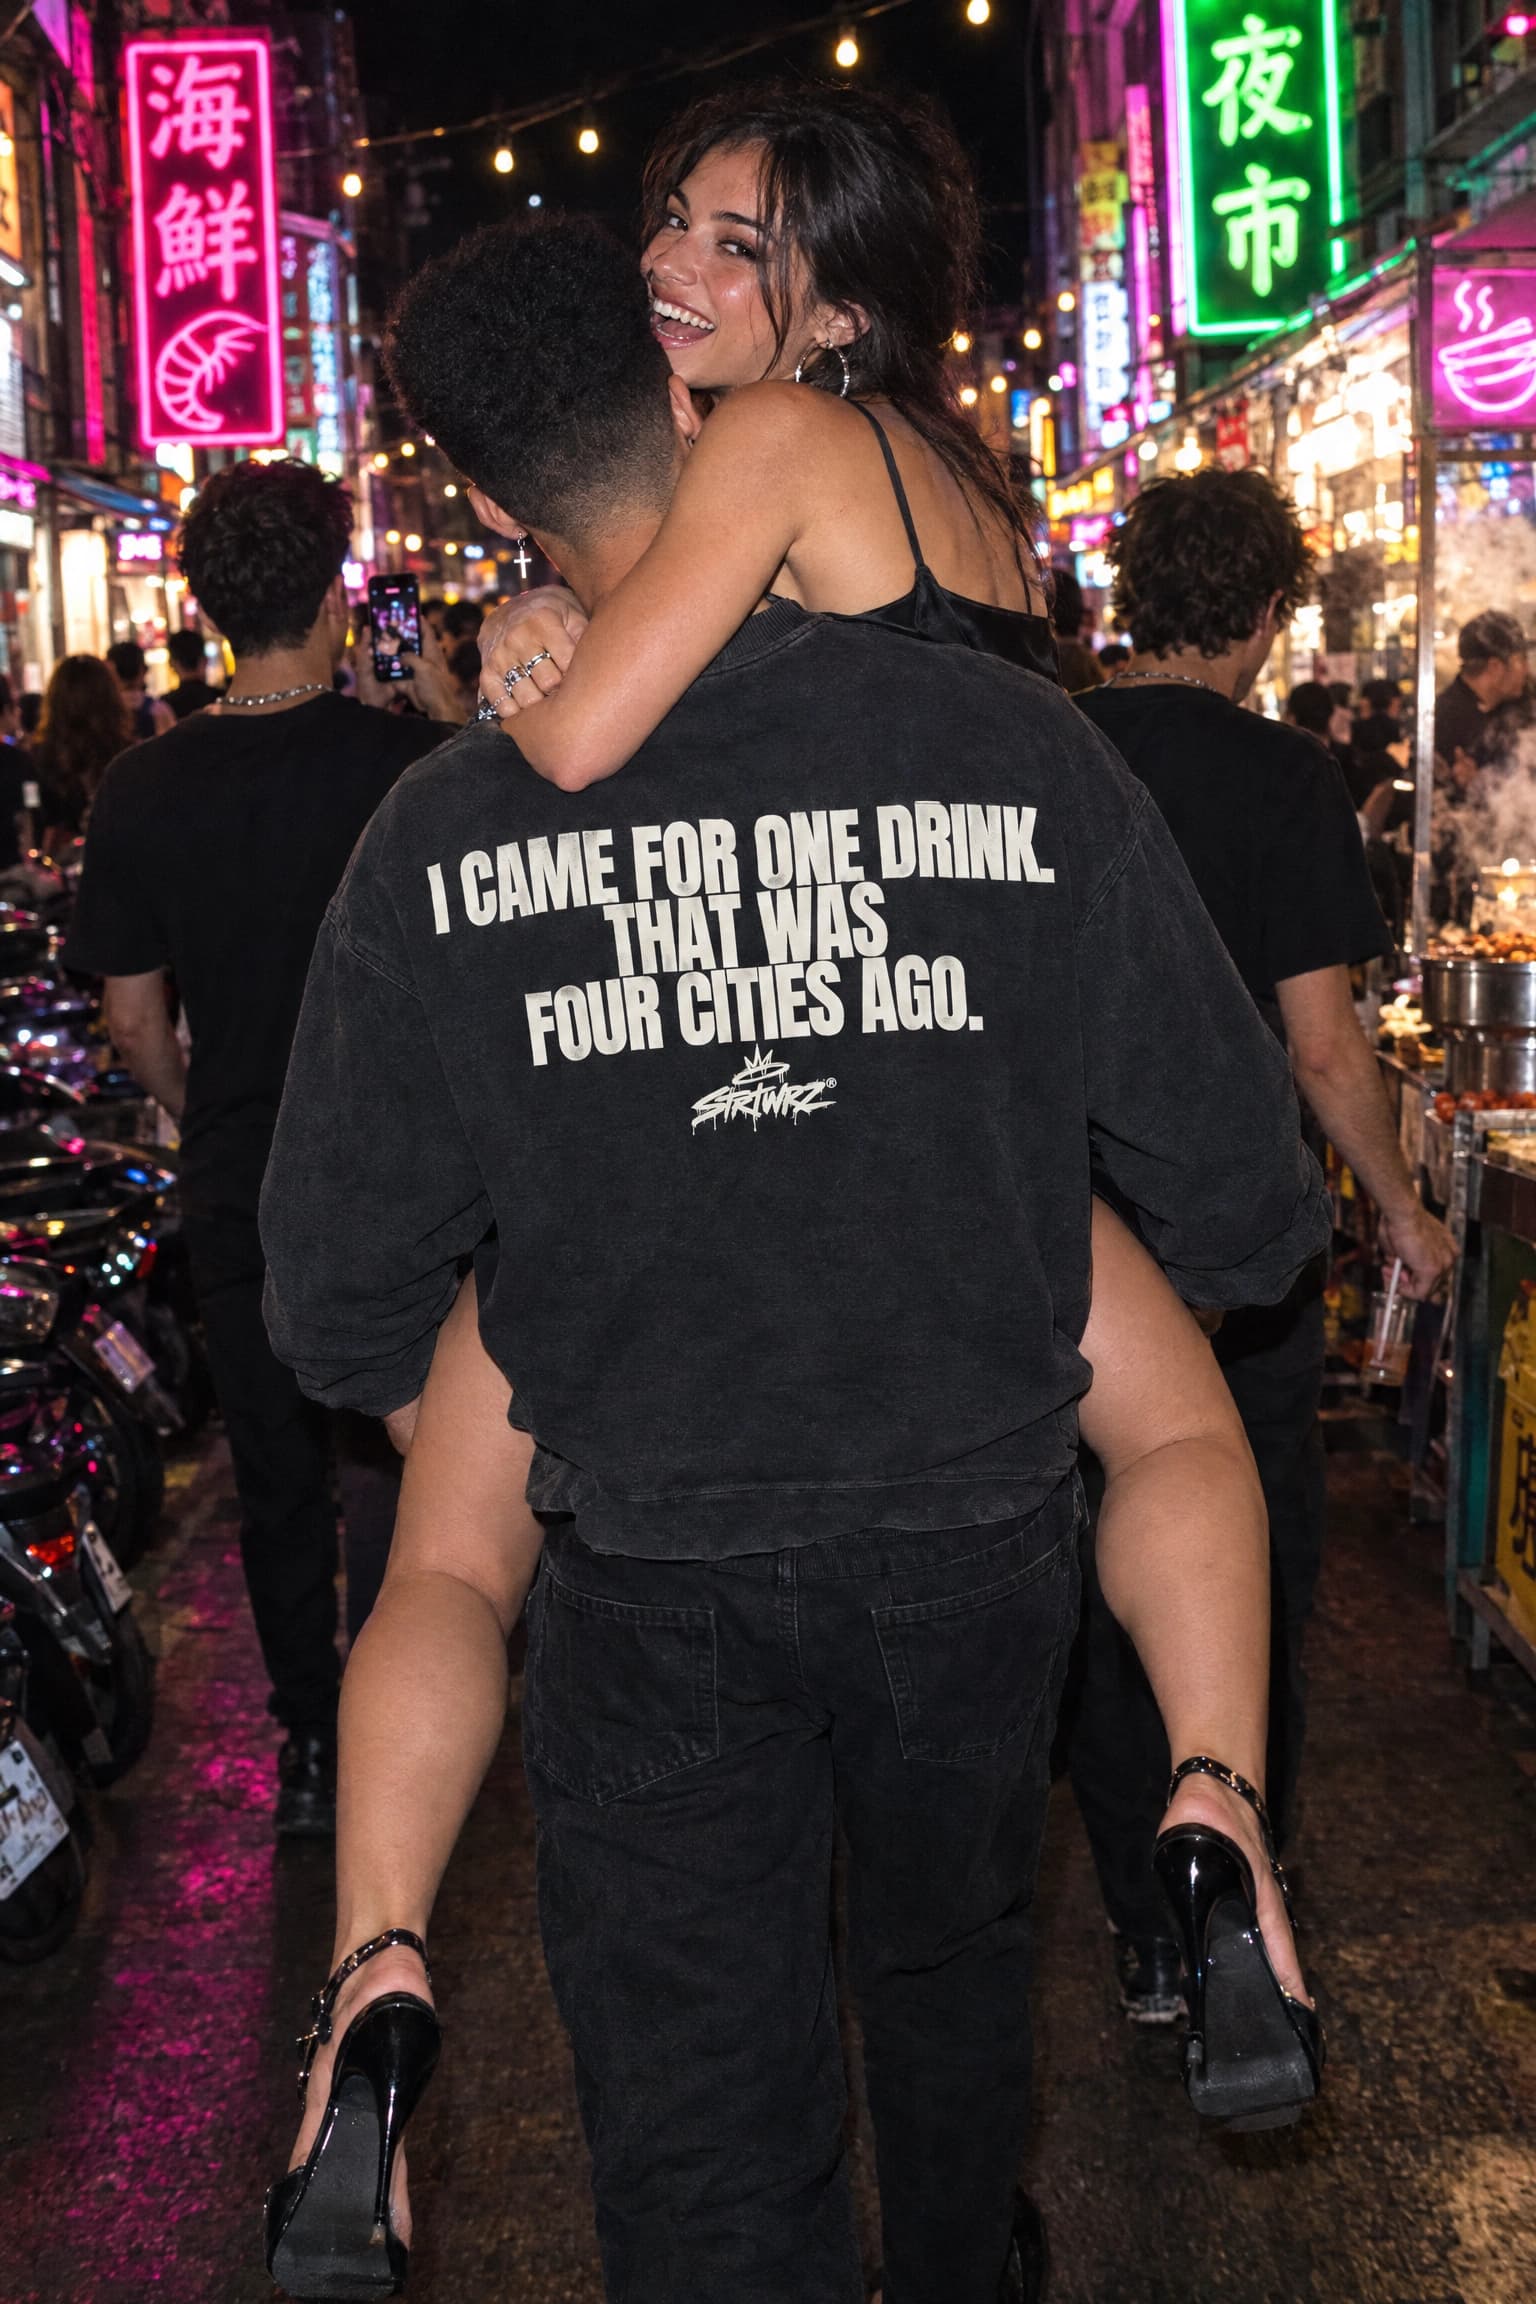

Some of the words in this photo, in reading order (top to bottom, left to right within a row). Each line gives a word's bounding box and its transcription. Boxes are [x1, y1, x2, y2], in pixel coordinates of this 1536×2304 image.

[147, 54, 259, 302] 海鮮
[1201, 13, 1313, 298] 夜市
[426, 862, 451, 935] I
[459, 828, 620, 927] CAME
[631, 818, 742, 901] FOR
[753, 808, 866, 890] ONE
[876, 800, 1056, 884] DRINK.
[602, 892, 742, 977] THAT
[756, 881, 889, 965] WAS
[524, 975, 664, 1067] FOUR
[676, 960, 845, 1047] CITIES
[861, 954, 984, 1034] AGO.
